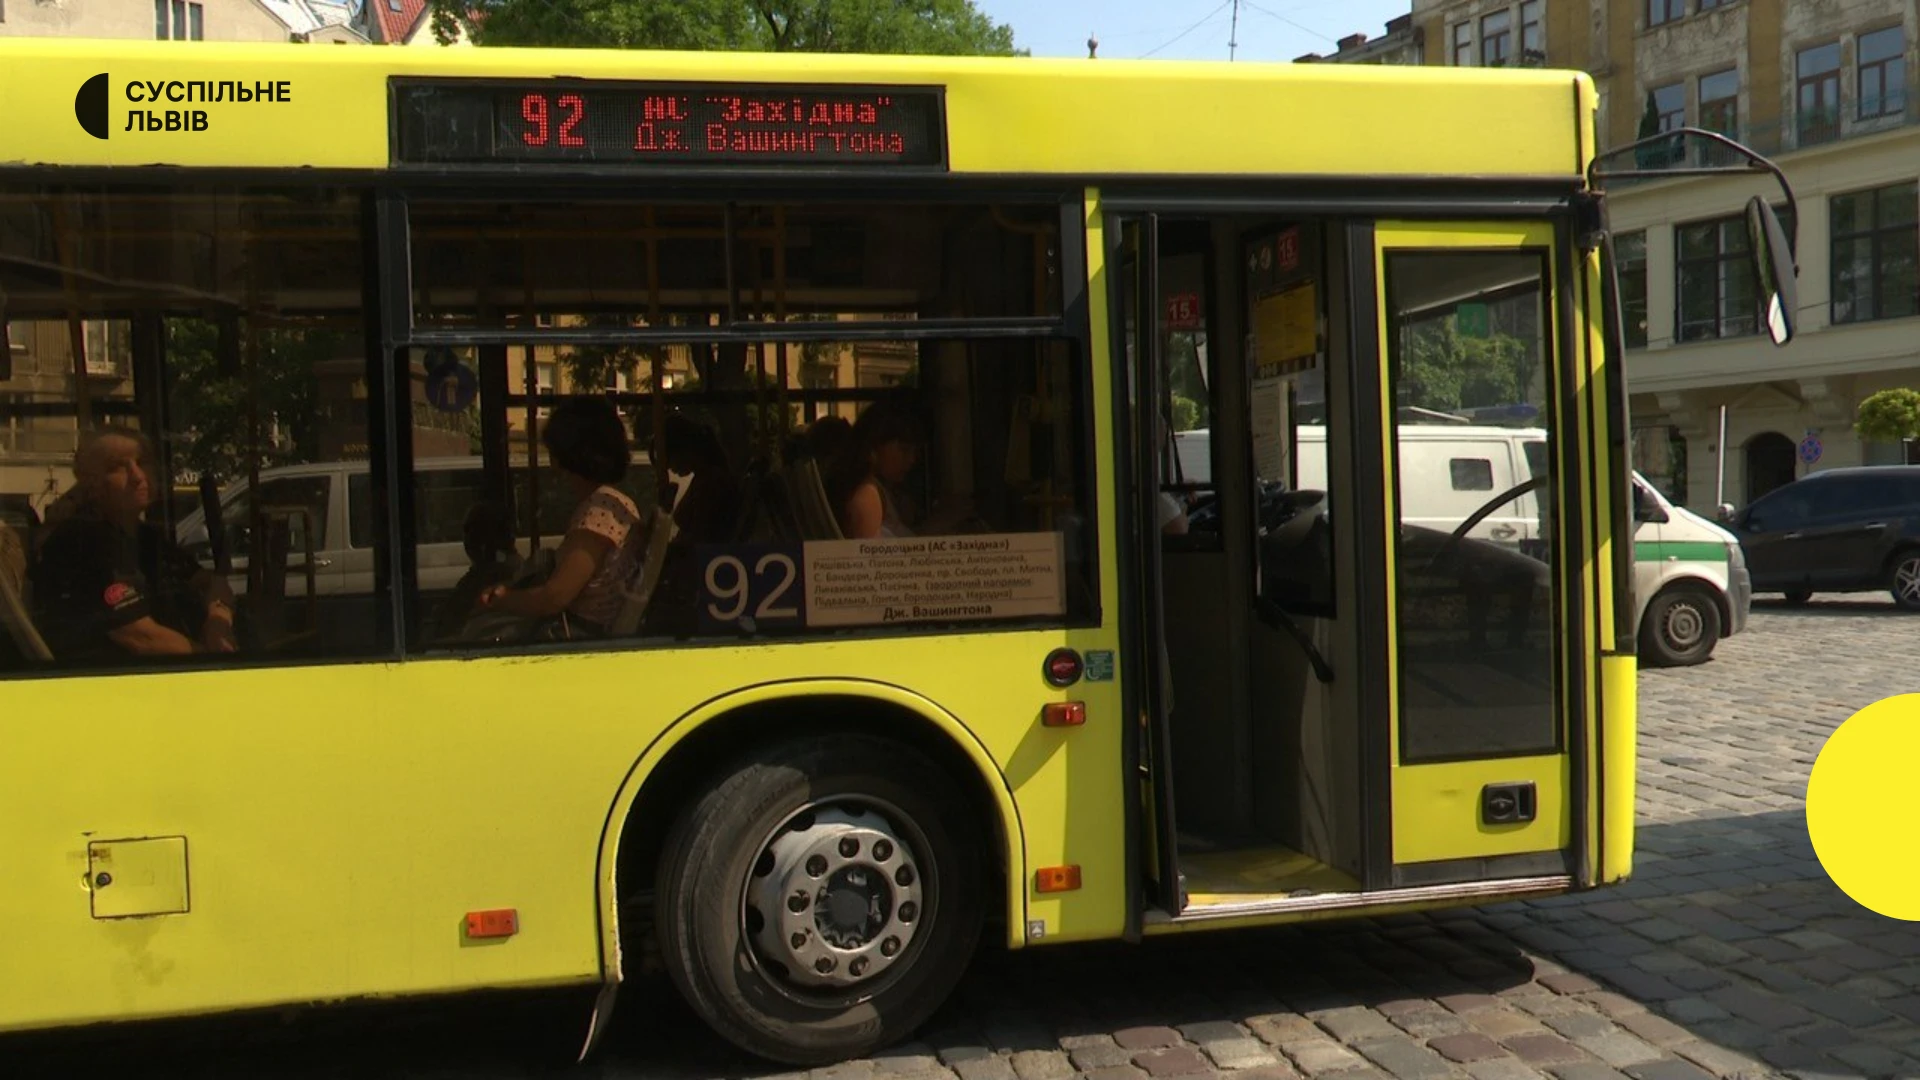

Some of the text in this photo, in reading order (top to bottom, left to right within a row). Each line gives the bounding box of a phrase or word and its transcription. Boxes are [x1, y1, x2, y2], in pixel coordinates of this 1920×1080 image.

[521, 93, 584, 147] 92
[705, 96, 892, 126] "Західна"
[634, 122, 905, 154] Дж. Вашингтона
[860, 543, 925, 555] Городоцька
[928, 540, 948, 552] (АС
[704, 553, 798, 621] 92
[883, 604, 992, 621] Дж. Вашингтона
